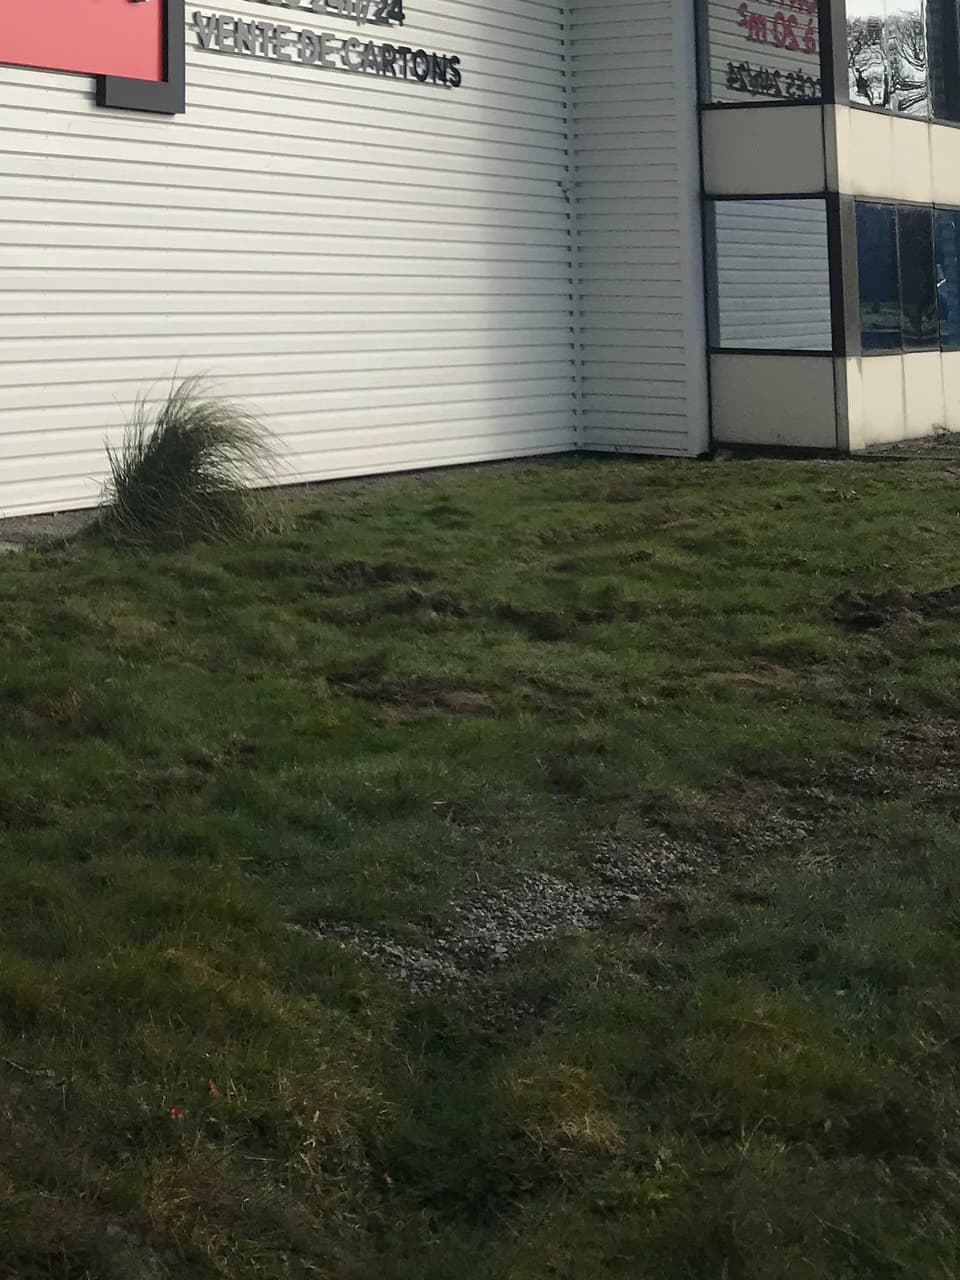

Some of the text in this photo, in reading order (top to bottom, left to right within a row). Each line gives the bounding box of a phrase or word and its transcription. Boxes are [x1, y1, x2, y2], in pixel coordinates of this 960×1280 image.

[193, 11, 462, 88] VENTE DE CARTONS
